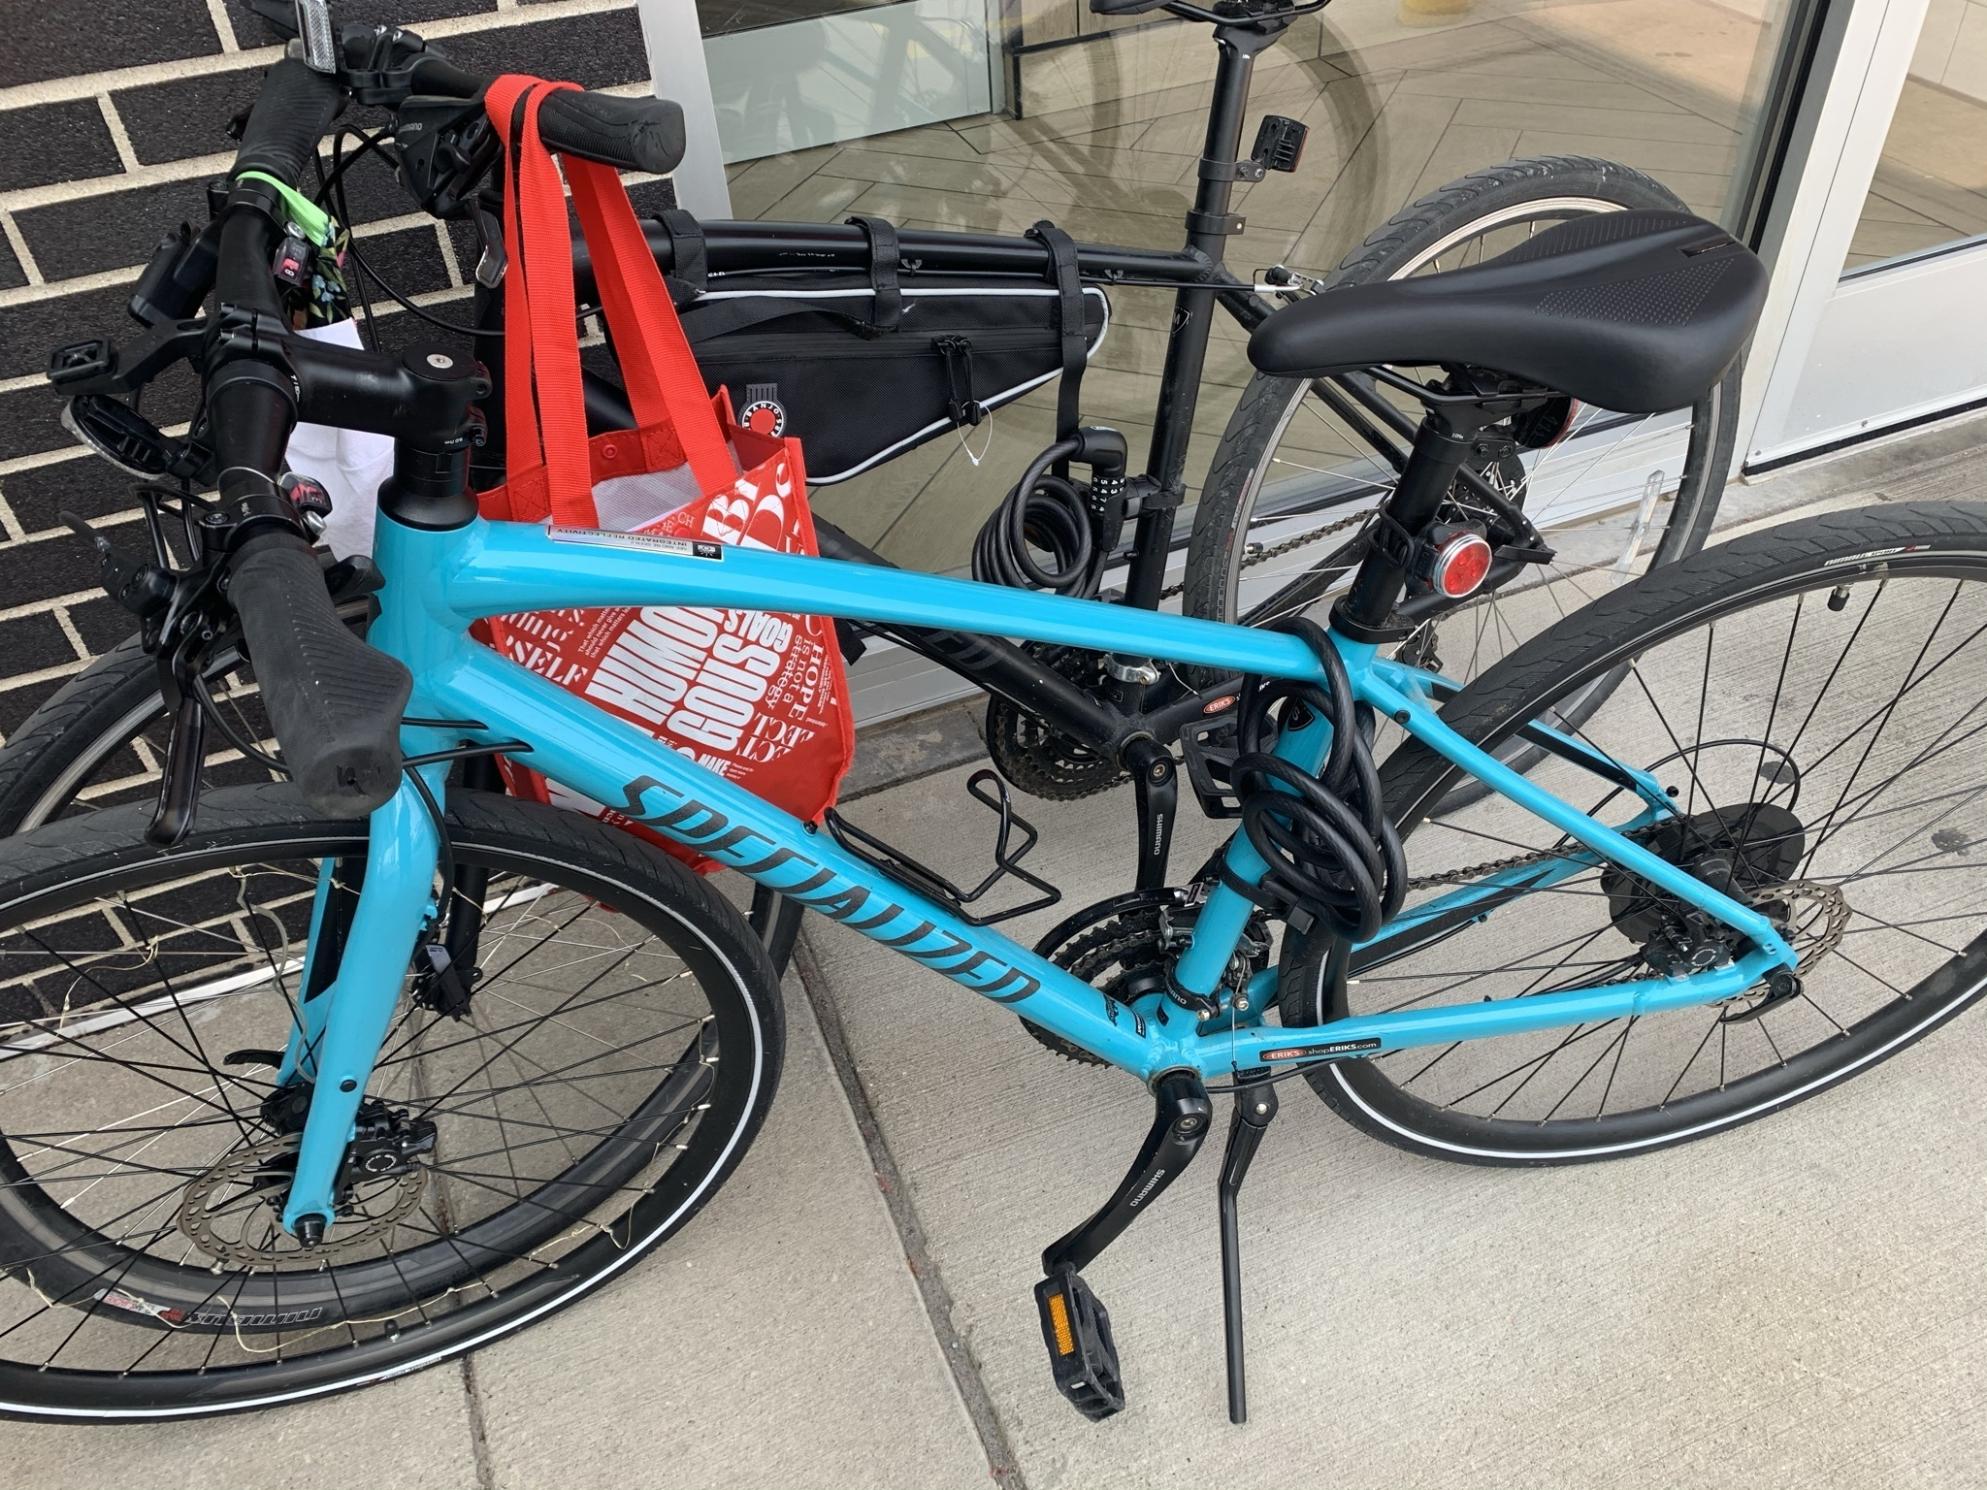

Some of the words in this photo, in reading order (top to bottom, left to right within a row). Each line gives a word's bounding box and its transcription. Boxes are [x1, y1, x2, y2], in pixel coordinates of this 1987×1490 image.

[584, 607, 725, 725] HUMO
[666, 633, 780, 751] GOUS
[765, 635, 802, 709] strategy
[788, 643, 823, 721] HOPE
[790, 660, 807, 691] not
[1154, 813, 1164, 856] SHIMANO
[608, 775, 1041, 1003] SPECIALIZED
[1271, 1050, 1300, 1060] ERIKS
[1307, 1042, 1377, 1055] shopERIKS.com
[1129, 1168, 1166, 1207] SHIMANO
